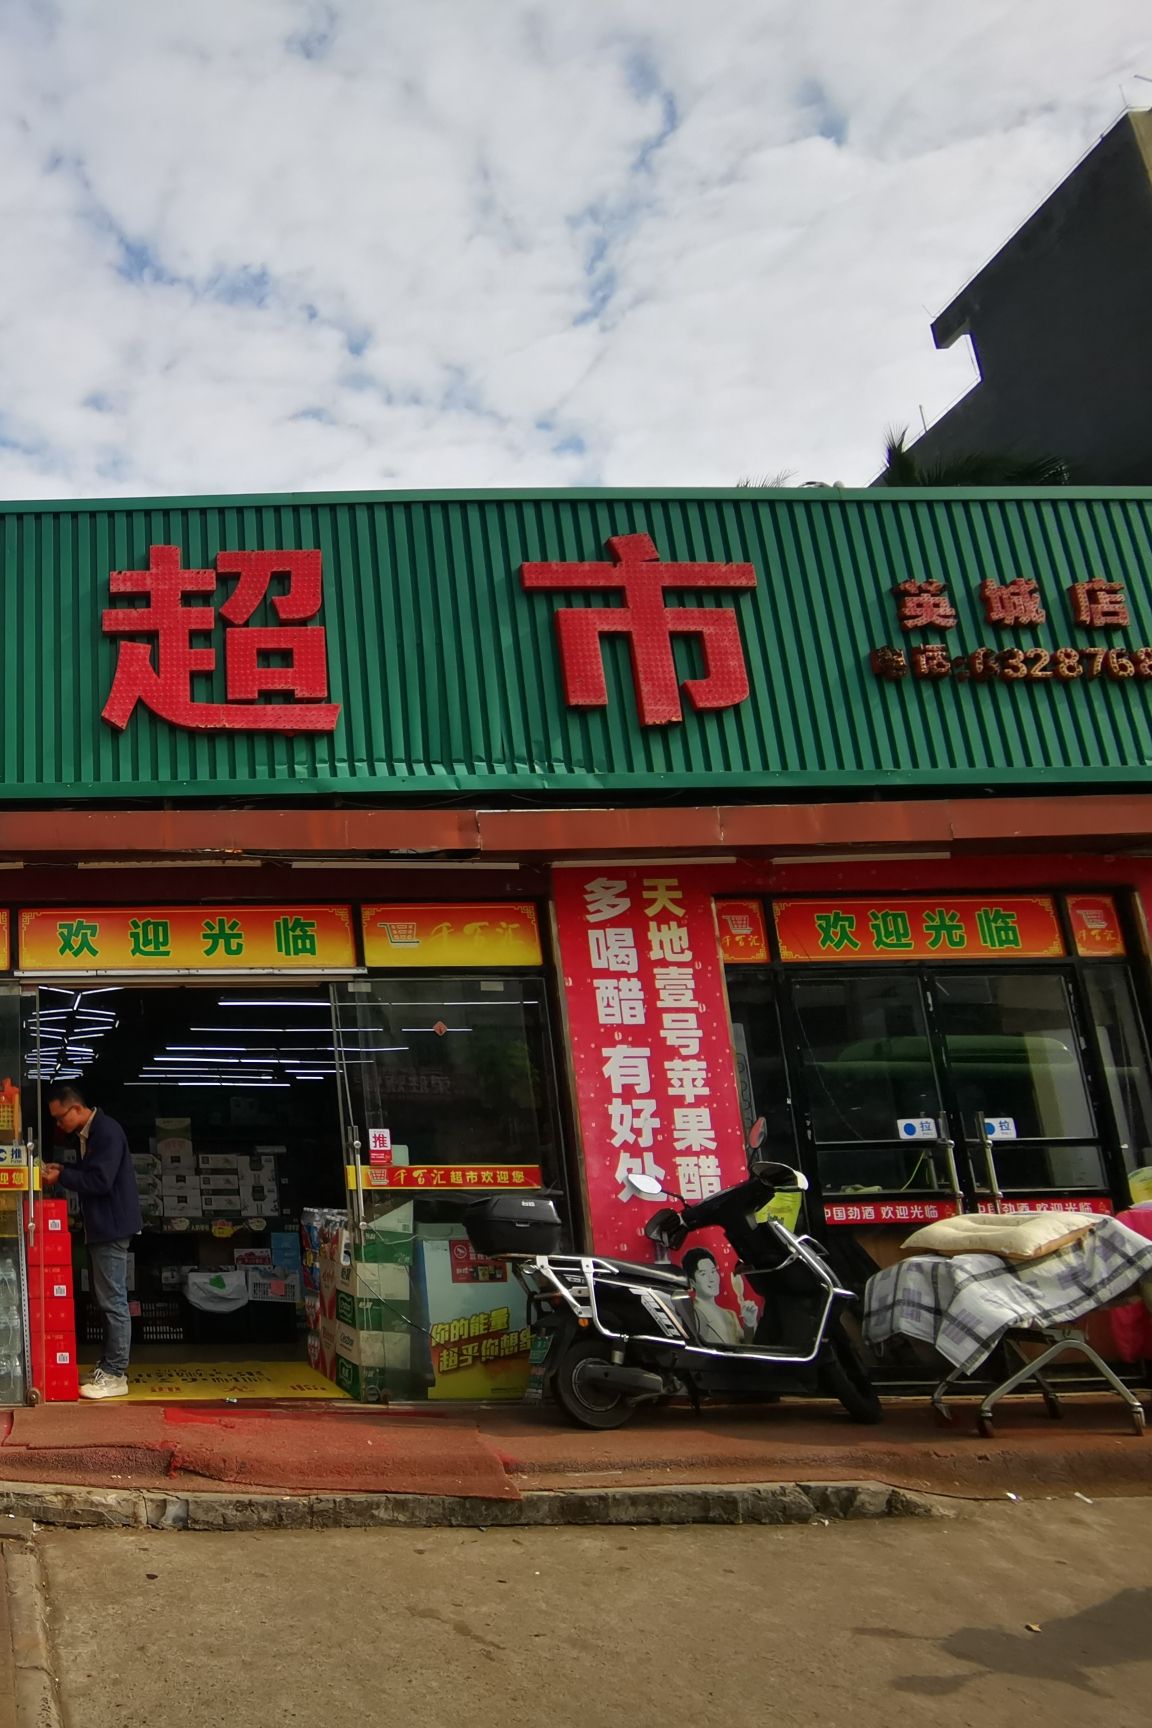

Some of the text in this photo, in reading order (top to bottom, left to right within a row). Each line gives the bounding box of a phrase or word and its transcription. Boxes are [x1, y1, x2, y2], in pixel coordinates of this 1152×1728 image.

[57, 917, 317, 959] 欢迎光临
[428, 921, 525, 948] 千百汇
[814, 907, 1022, 952] 欢迎光临
[583, 876, 668, 1204] 多喝醋 有好处
[641, 878, 723, 1200] 天地壹号苹果醋
[372, 1133, 388, 1148] 推
[394, 1168, 525, 1185] 千百汇超市欢迎您
[881, 1205, 938, 1219] 欢迎光临
[431, 1306, 510, 1346] 你的能量
